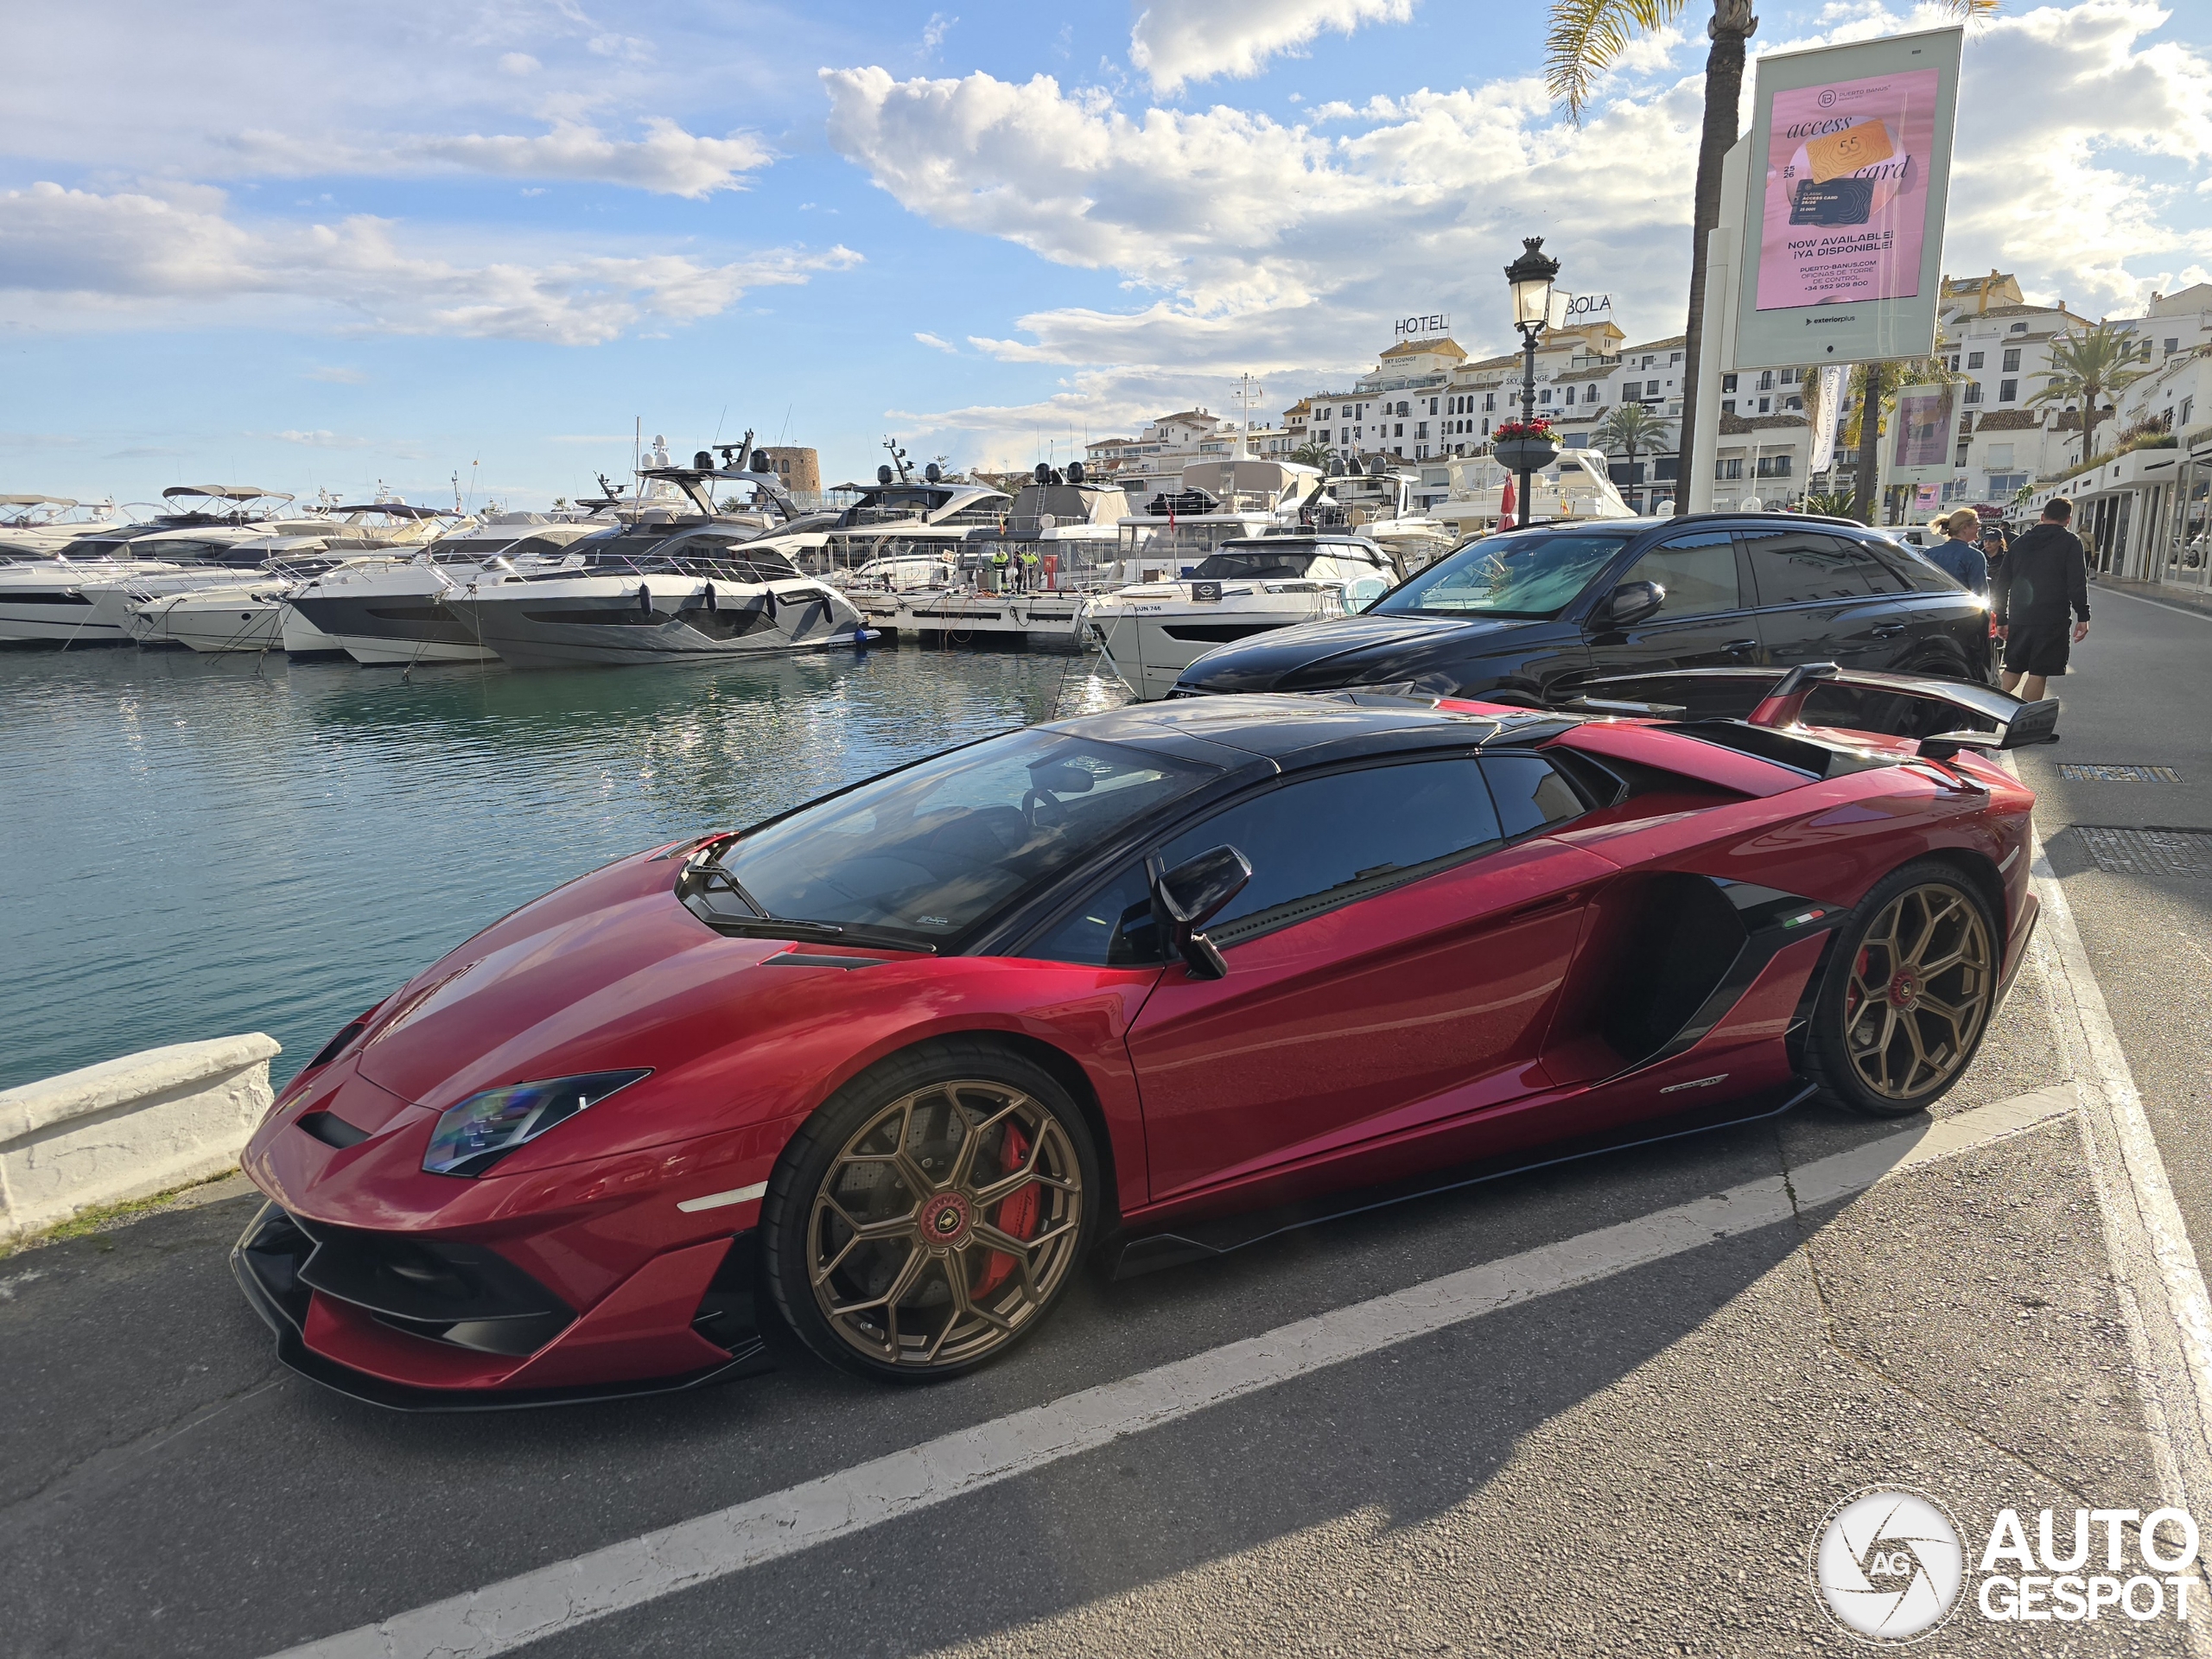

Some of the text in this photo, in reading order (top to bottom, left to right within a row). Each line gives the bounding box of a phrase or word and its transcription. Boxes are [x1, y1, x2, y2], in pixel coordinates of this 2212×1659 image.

[1839, 89, 1865, 98] PUERTO
[1787, 116, 1853, 139] access
[1837, 136, 1861, 156] 55
[1853, 154, 1911, 181] card
[1788, 230, 1894, 250] NOW AVAILABLE!
[1794, 240, 1892, 260] ¡YA DISPONIBLE!
[1800, 260, 1877, 273] PUERTO-BANUS.COM
[1801, 270, 1834, 279] OFICINAS
[1849, 266, 1874, 275] TORRE
[1825, 275, 1860, 283] CONTROL
[1395, 314, 1448, 335] HOTEL
[1814, 315, 1856, 324] exteriorplus
[1395, 355, 1417, 364] LOUNGE
[1505, 374, 1550, 385] SKY LNGE
[1821, 409, 1833, 453] PUERTO
